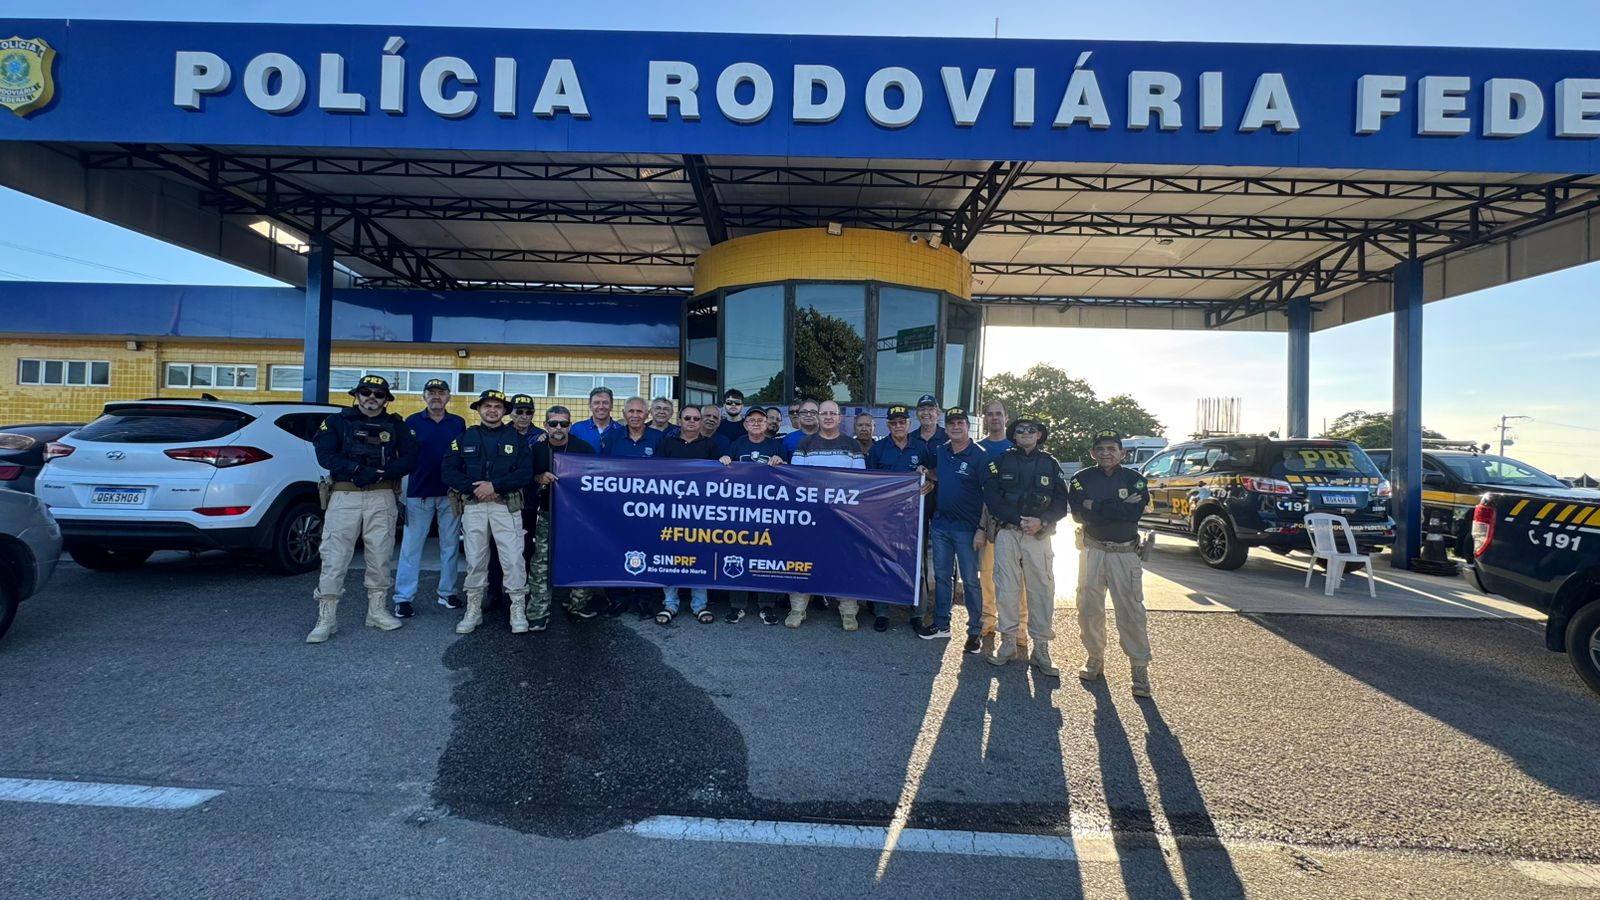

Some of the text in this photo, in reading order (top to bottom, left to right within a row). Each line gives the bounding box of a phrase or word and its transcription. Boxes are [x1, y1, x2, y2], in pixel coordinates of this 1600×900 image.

[174, 36, 590, 118] POLÍCIA
[648, 50, 1300, 132] RODOVIÁRIA
[488, 391, 505, 400] PRF
[890, 406, 906, 414] PRF
[947, 408, 963, 416] PRF
[1298, 450, 1355, 469] PRF
[580, 475, 860, 505] SEGURANÇA PÚBLICA SE FAZ
[623, 501, 816, 526] COM INVESTIMENTO.
[1286, 502, 1309, 512] 191
[660, 526, 773, 546] #FUNCOCJÁ
[1543, 531, 1582, 551] 191
[653, 554, 697, 566] SINPRF
[749, 559, 813, 572] FENAPRF
[658, 566, 680, 574] Grande
